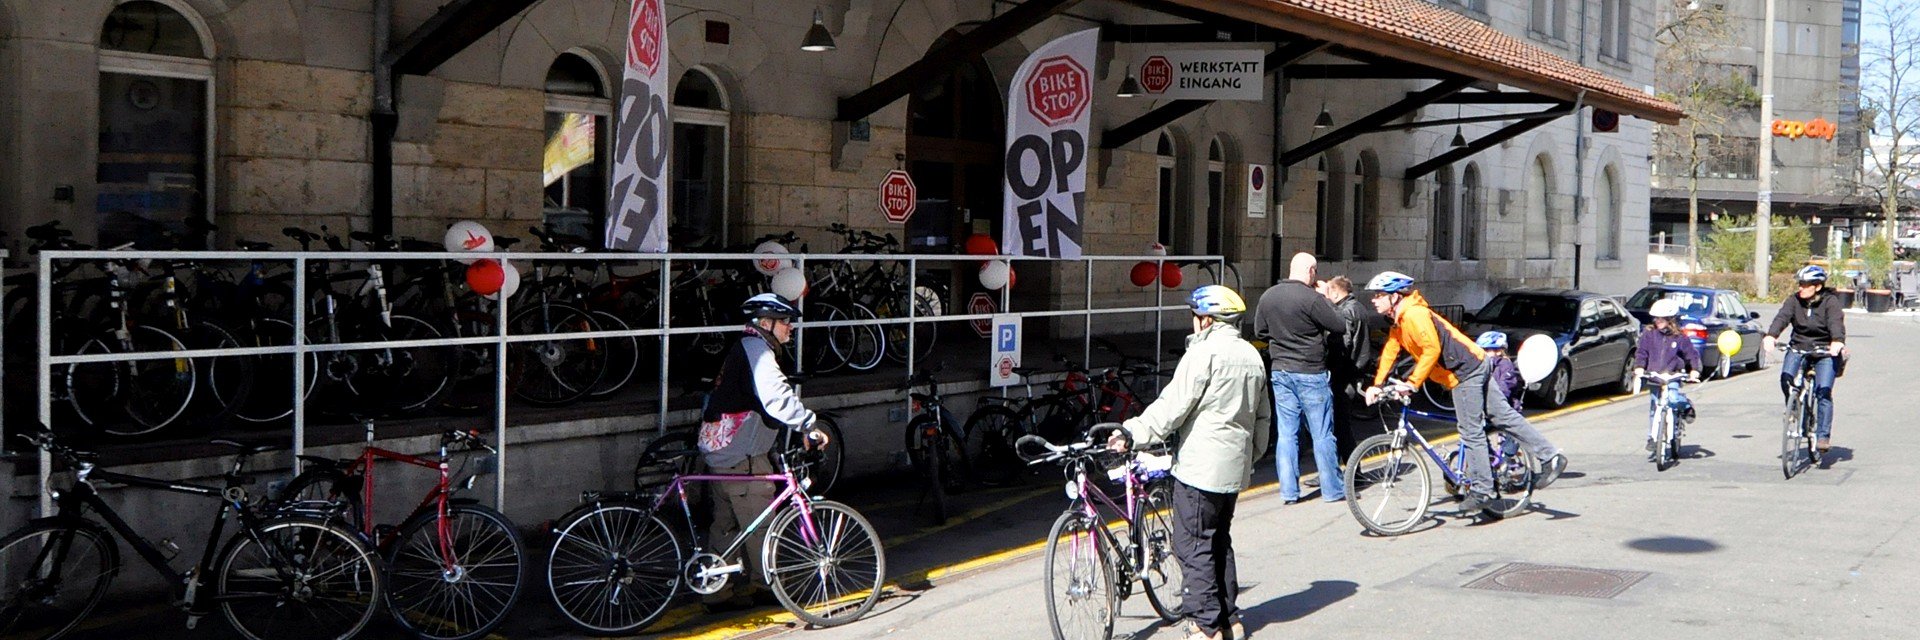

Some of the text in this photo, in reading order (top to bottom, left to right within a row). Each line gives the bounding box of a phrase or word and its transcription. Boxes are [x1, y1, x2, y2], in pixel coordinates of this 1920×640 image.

[1147, 64, 1166, 75] BIKE
[1180, 61, 1259, 73] WERKSTATT
[1040, 71, 1076, 94] BIKE
[1147, 76, 1166, 86] STOP
[1180, 77, 1242, 89] EINGANG
[1041, 91, 1077, 113] STOP
[1006, 129, 1085, 200] OP
[888, 183, 908, 197] BIKE
[887, 197, 908, 210] STOP
[1016, 191, 1085, 259] EN
[1002, 328, 1013, 349] P
